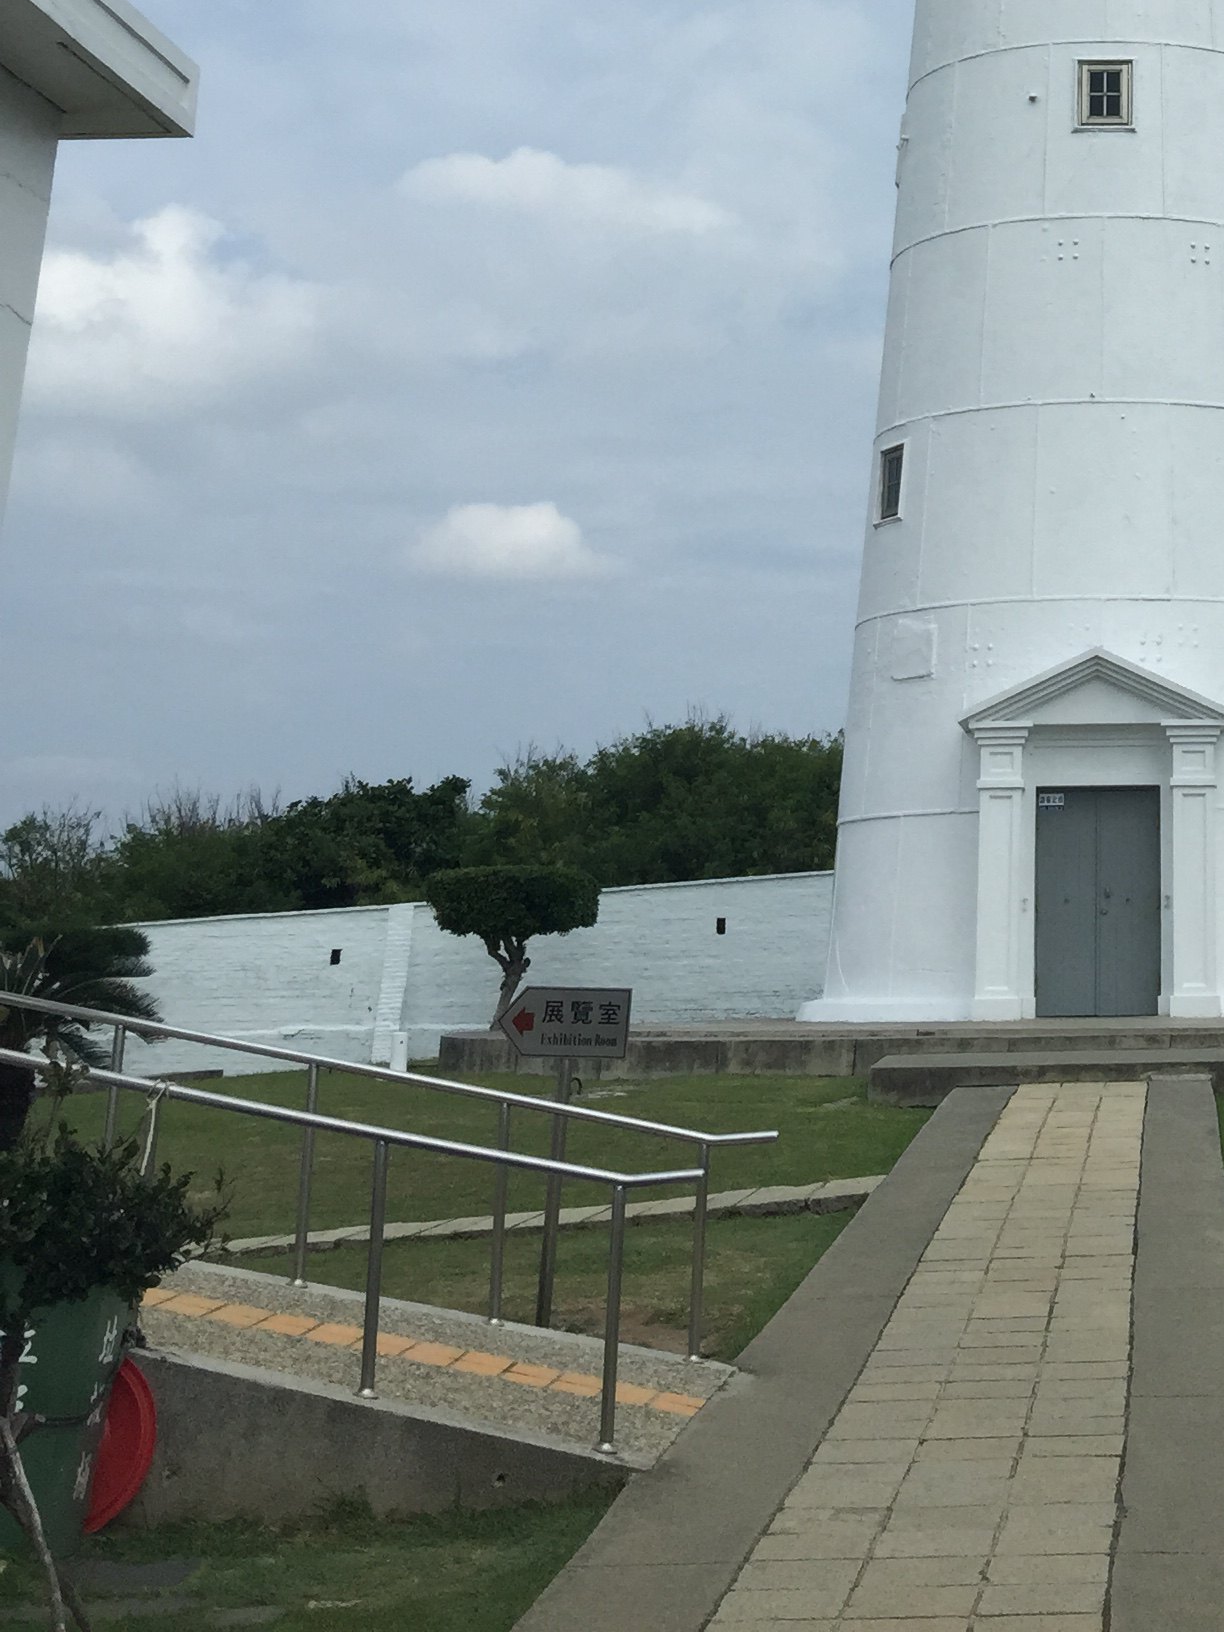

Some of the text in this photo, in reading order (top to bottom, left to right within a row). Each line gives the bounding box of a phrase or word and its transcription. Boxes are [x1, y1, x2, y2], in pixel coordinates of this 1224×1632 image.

[542, 999, 621, 1025] 展覽室
[541, 1032, 618, 1047] Exhibition Room
